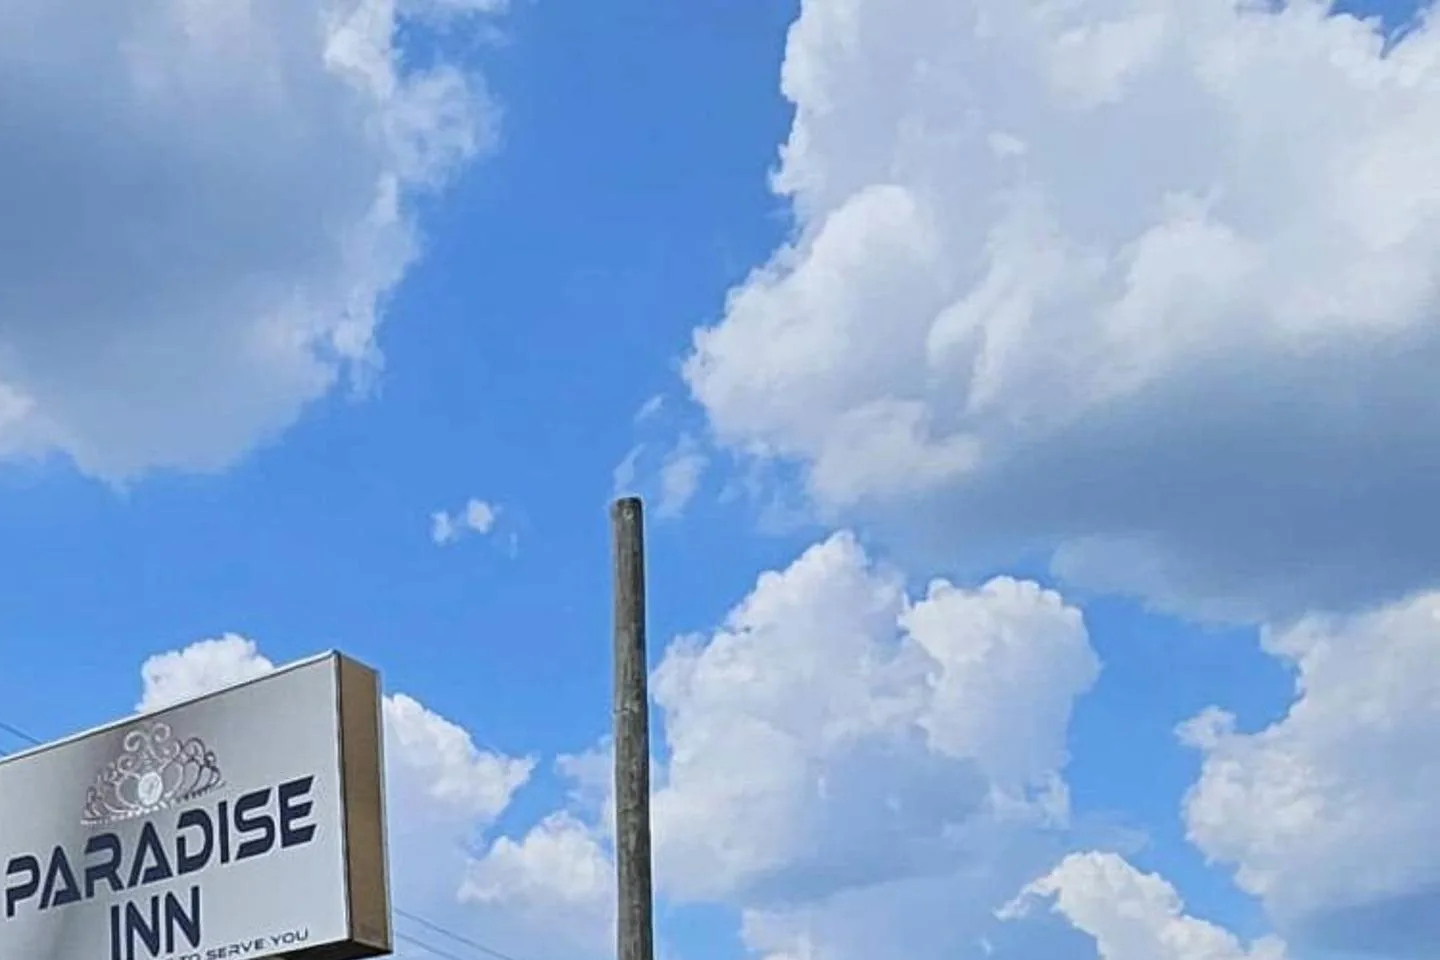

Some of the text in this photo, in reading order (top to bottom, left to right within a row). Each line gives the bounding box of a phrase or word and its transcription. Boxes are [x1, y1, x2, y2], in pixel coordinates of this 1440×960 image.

[6, 774, 317, 917] PARADISE
[206, 938, 264, 960] SERVE
[271, 926, 308, 944] YOU
